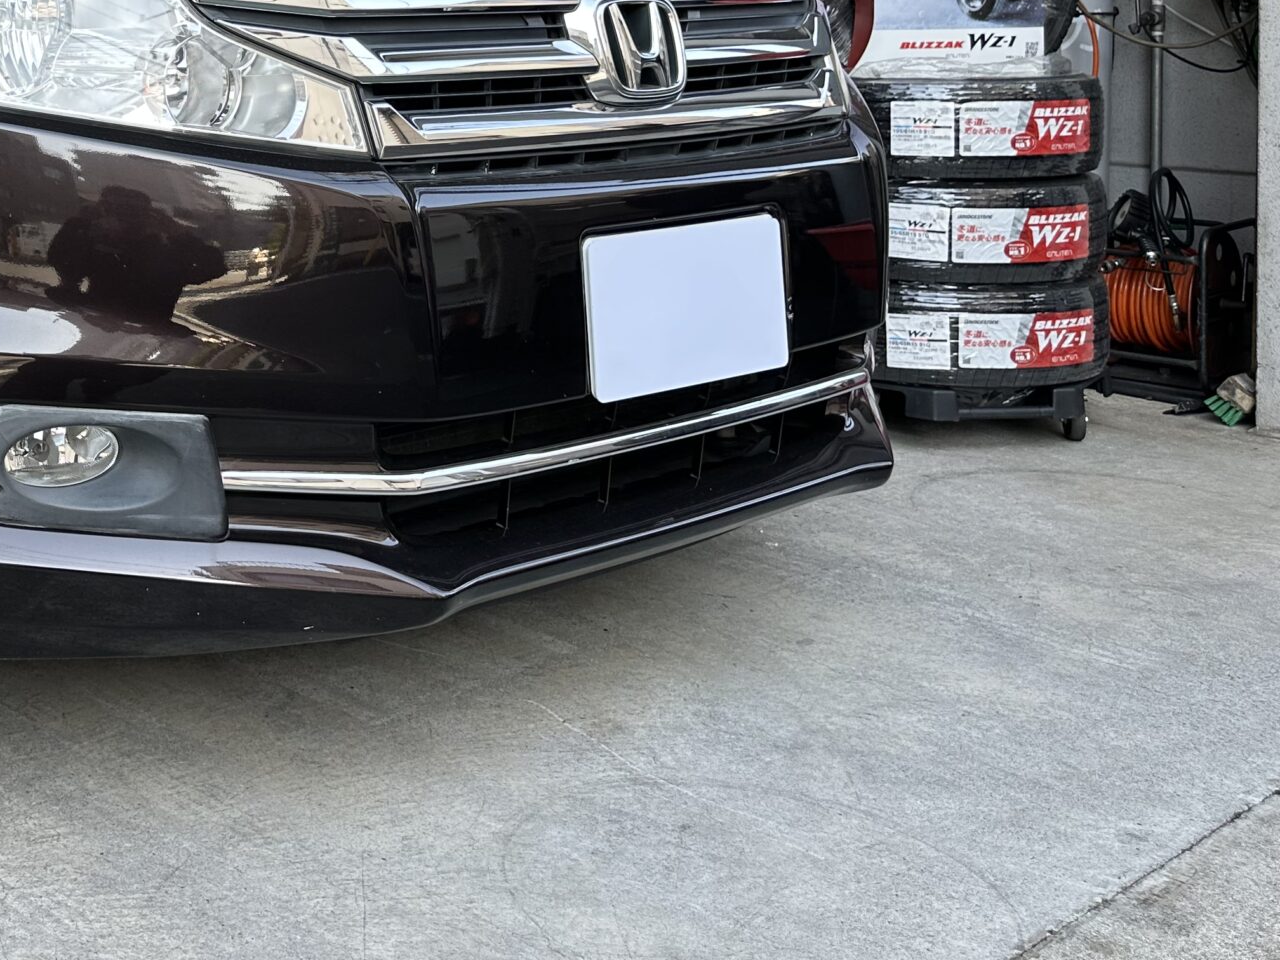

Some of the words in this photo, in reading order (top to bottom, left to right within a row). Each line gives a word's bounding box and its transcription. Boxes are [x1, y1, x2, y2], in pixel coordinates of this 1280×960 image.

[899, 40, 964, 50] BLIZZAK
[968, 33, 1017, 51] WZ-1
[1034, 105, 1089, 117] BLIZZAK
[1034, 118, 1084, 140] WZ-1
[1028, 211, 1087, 224] BLIZZAK
[1029, 224, 1081, 249] WZ-1
[1034, 315, 1092, 329] BLIZZAK
[1035, 330, 1087, 354] WZ-1
